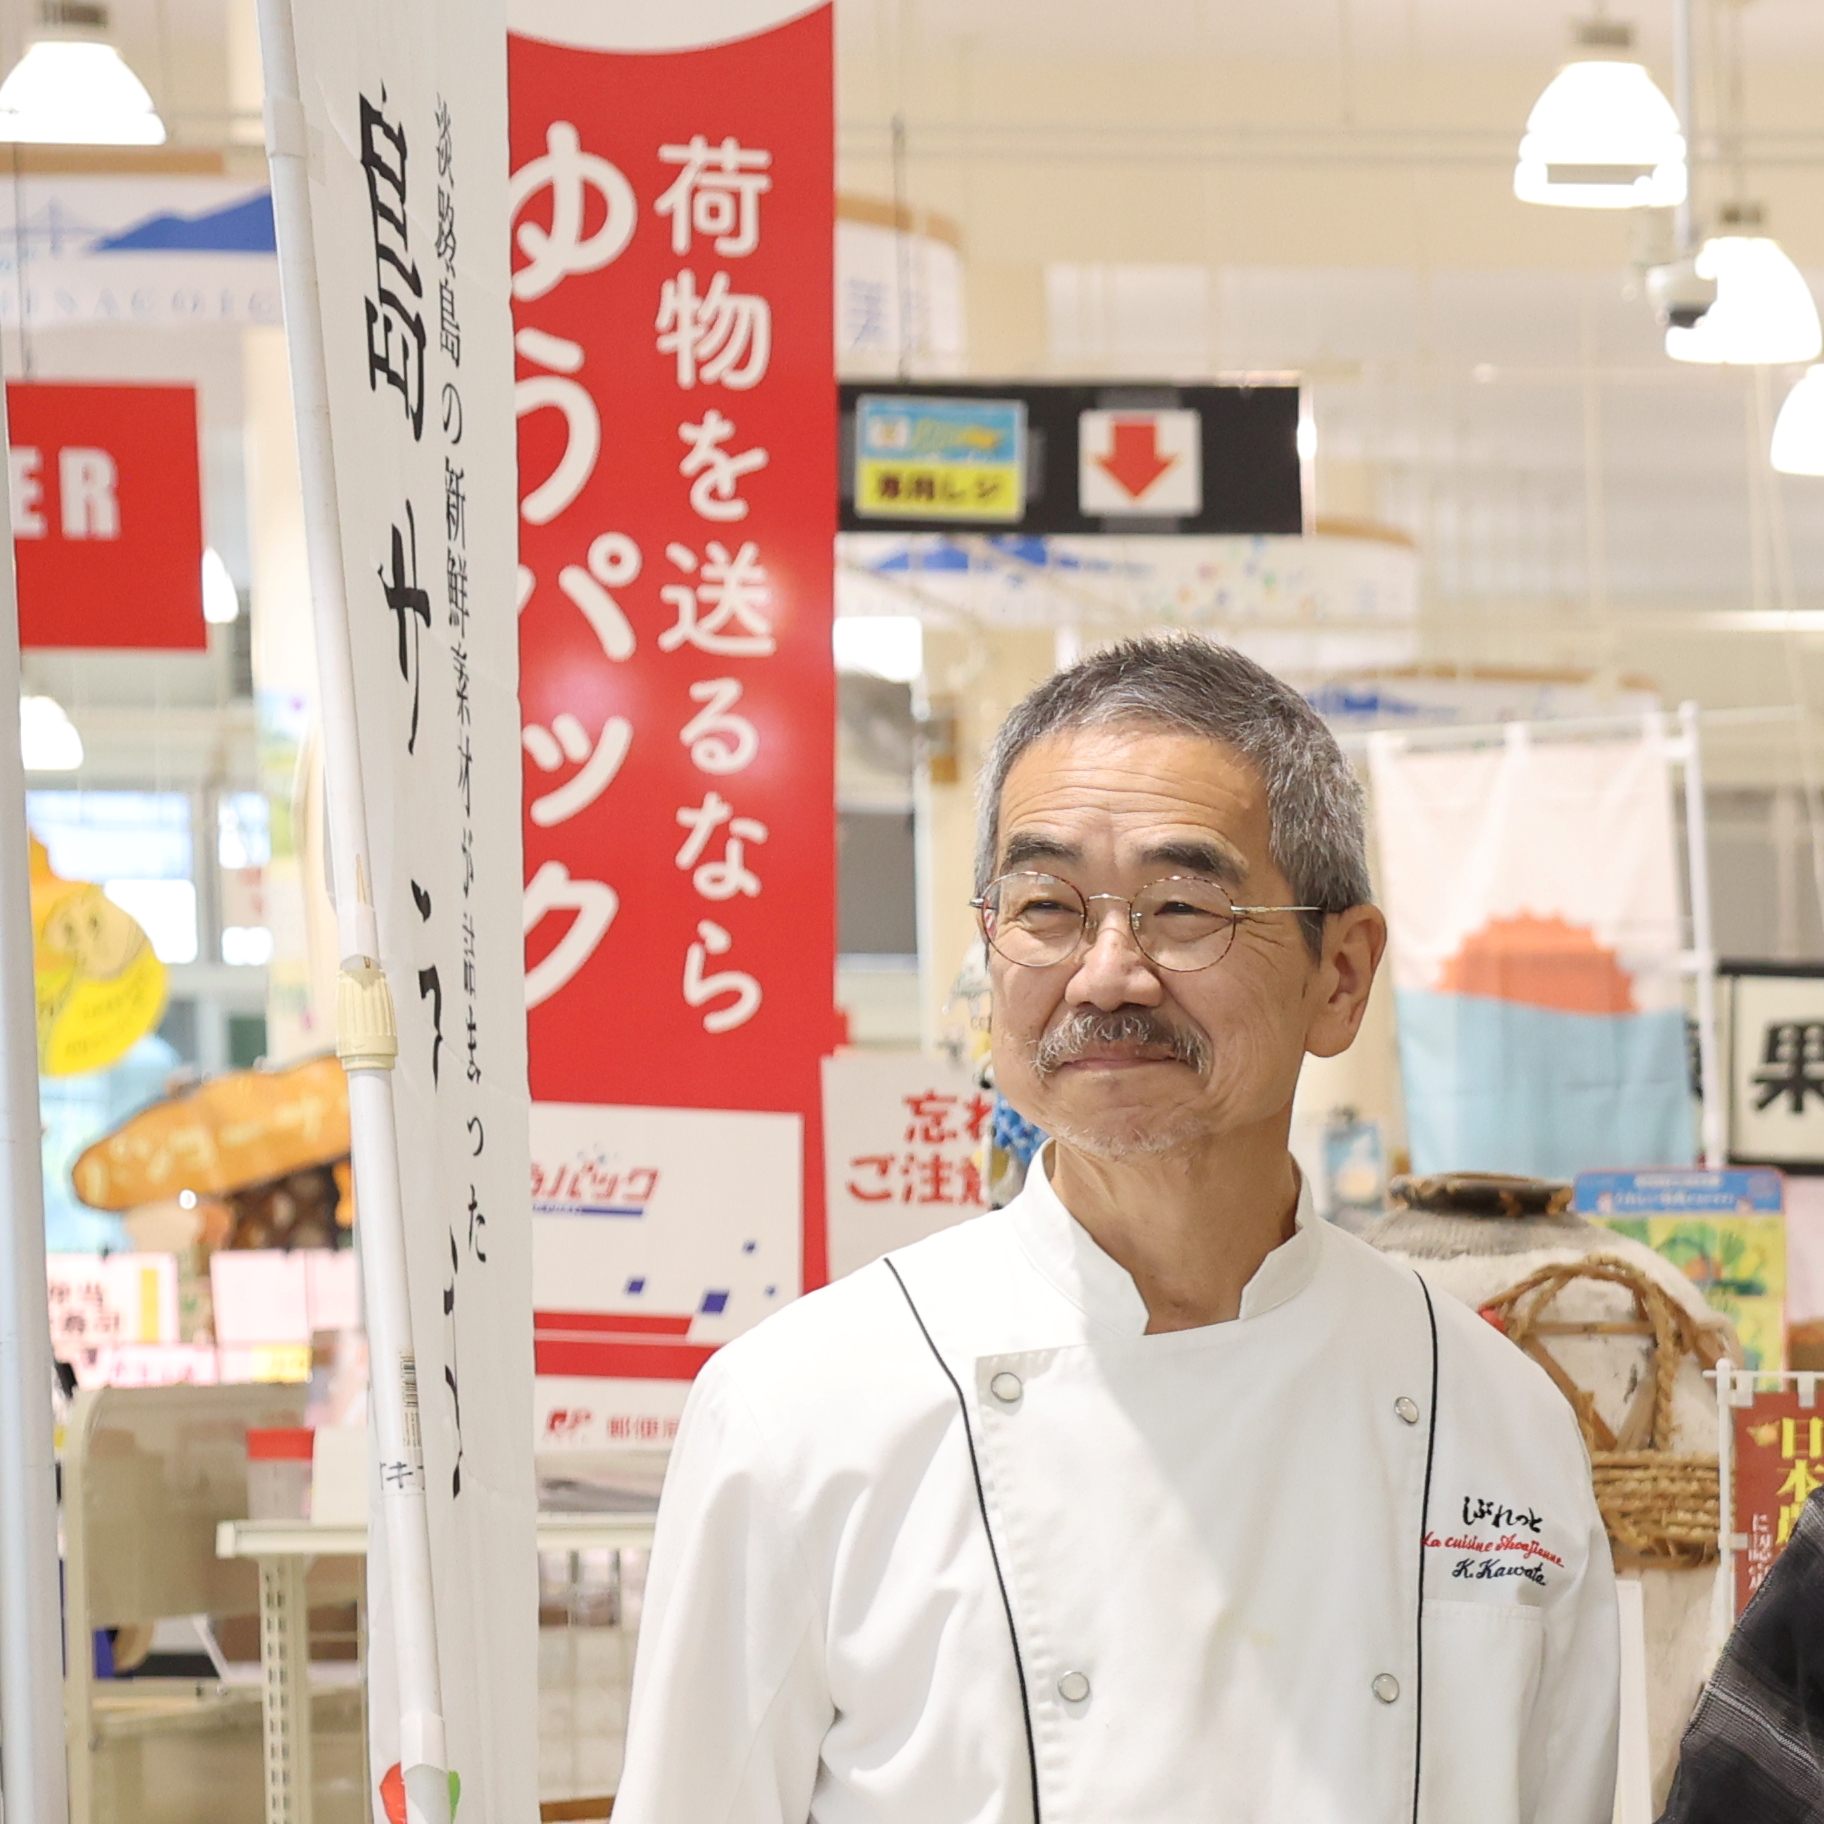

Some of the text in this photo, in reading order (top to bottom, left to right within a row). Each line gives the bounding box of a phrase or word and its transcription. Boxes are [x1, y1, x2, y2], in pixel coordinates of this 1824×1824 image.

[509, 119, 642, 1011] ゆうパック
[654, 135, 777, 1033] 荷物を送るなら
[1444, 1534, 1494, 1553] cuisine
